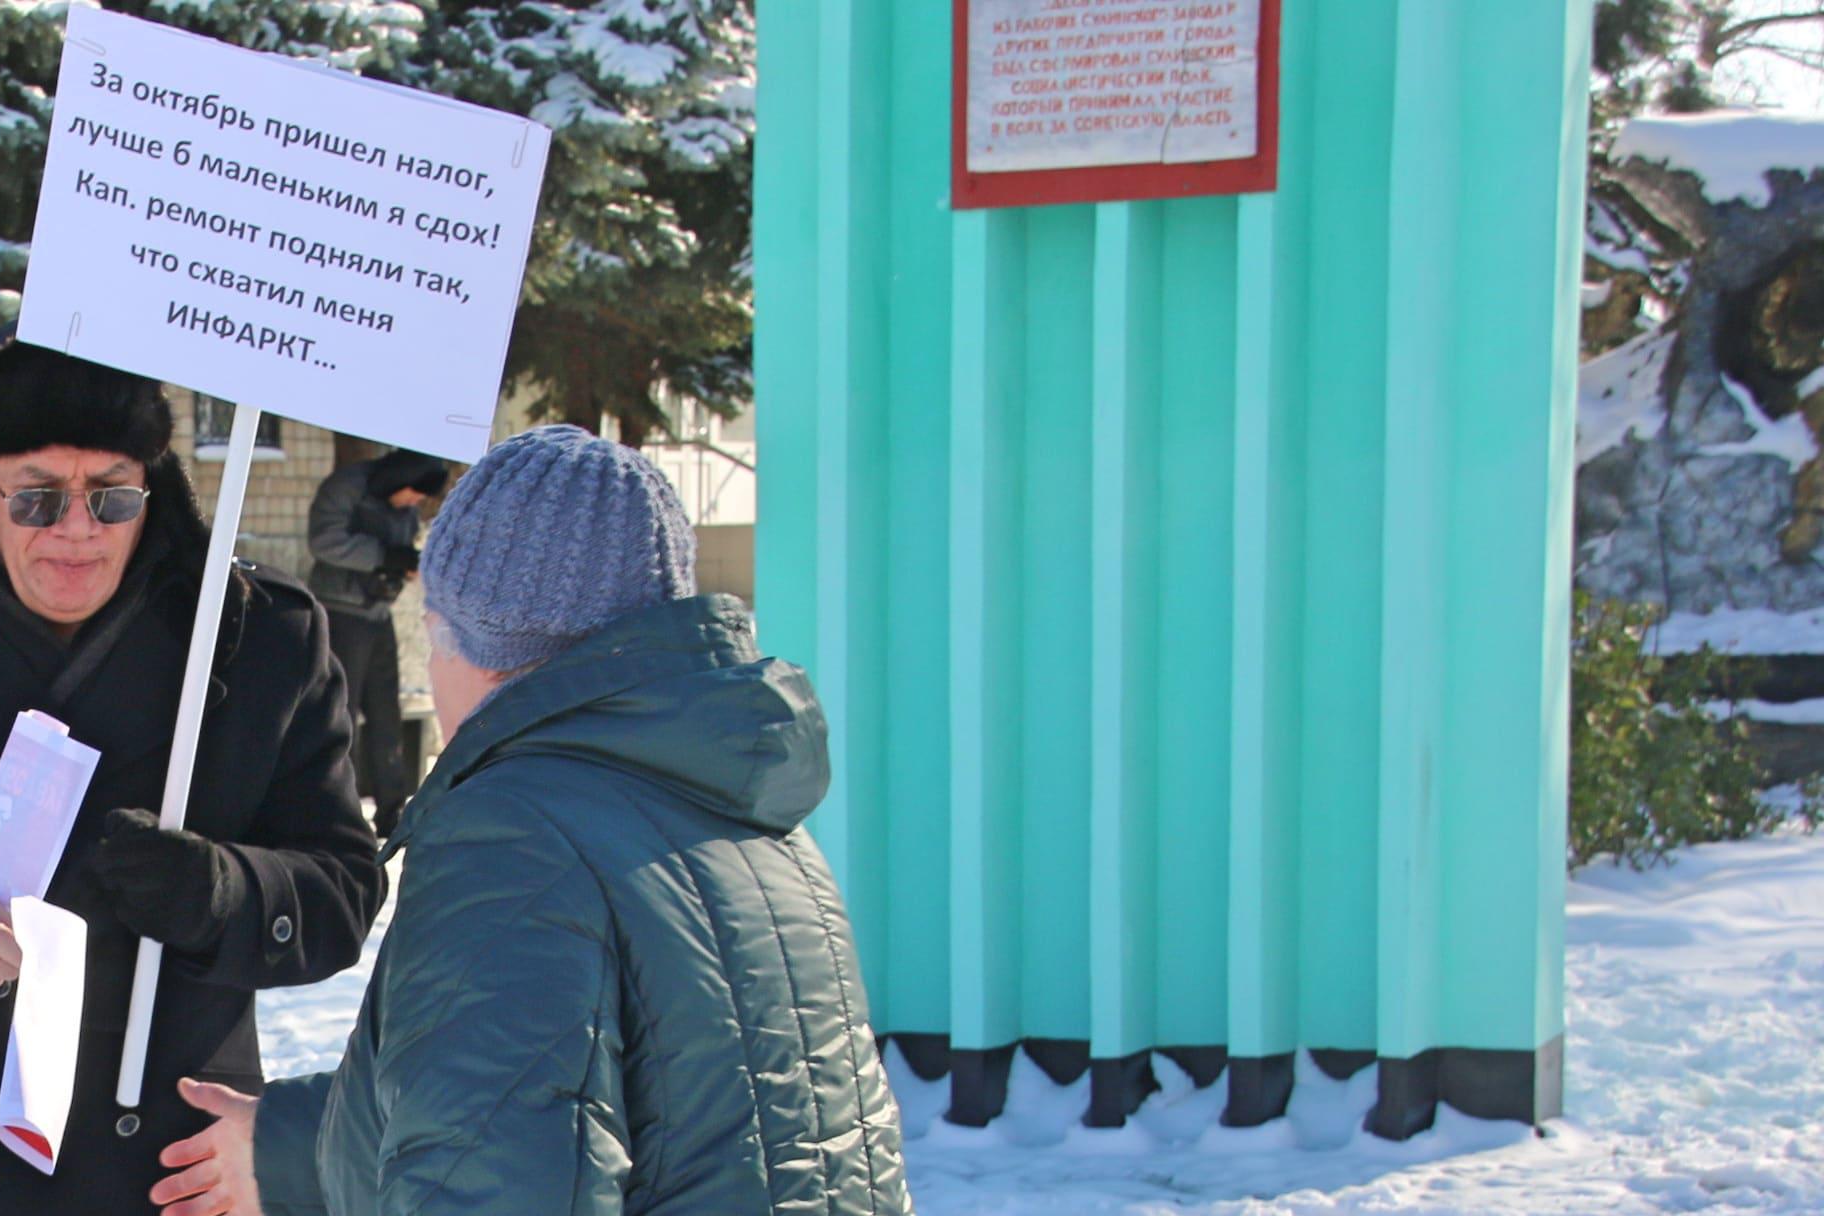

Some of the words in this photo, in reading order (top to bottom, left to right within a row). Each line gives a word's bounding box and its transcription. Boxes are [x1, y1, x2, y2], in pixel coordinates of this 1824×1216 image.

[69, 116, 164, 160] лучше
[172, 136, 193, 166] б
[200, 153, 378, 219] маленьким
[387, 203, 406, 226] я
[415, 213, 501, 249] сдох!
[89, 63, 123, 95] За
[133, 78, 255, 132] октябрь
[264, 116, 387, 168] пришел
[396, 154, 495, 198] налог,
[75, 169, 136, 210] Кап.
[146, 193, 262, 245] ремонт
[269, 230, 403, 284] подняли
[412, 267, 471, 305] так,
[131, 241, 179, 273] что
[188, 256, 304, 309] схватил
[313, 295, 395, 333] меня
[165, 300, 337, 371] ИНФАРКТ...
